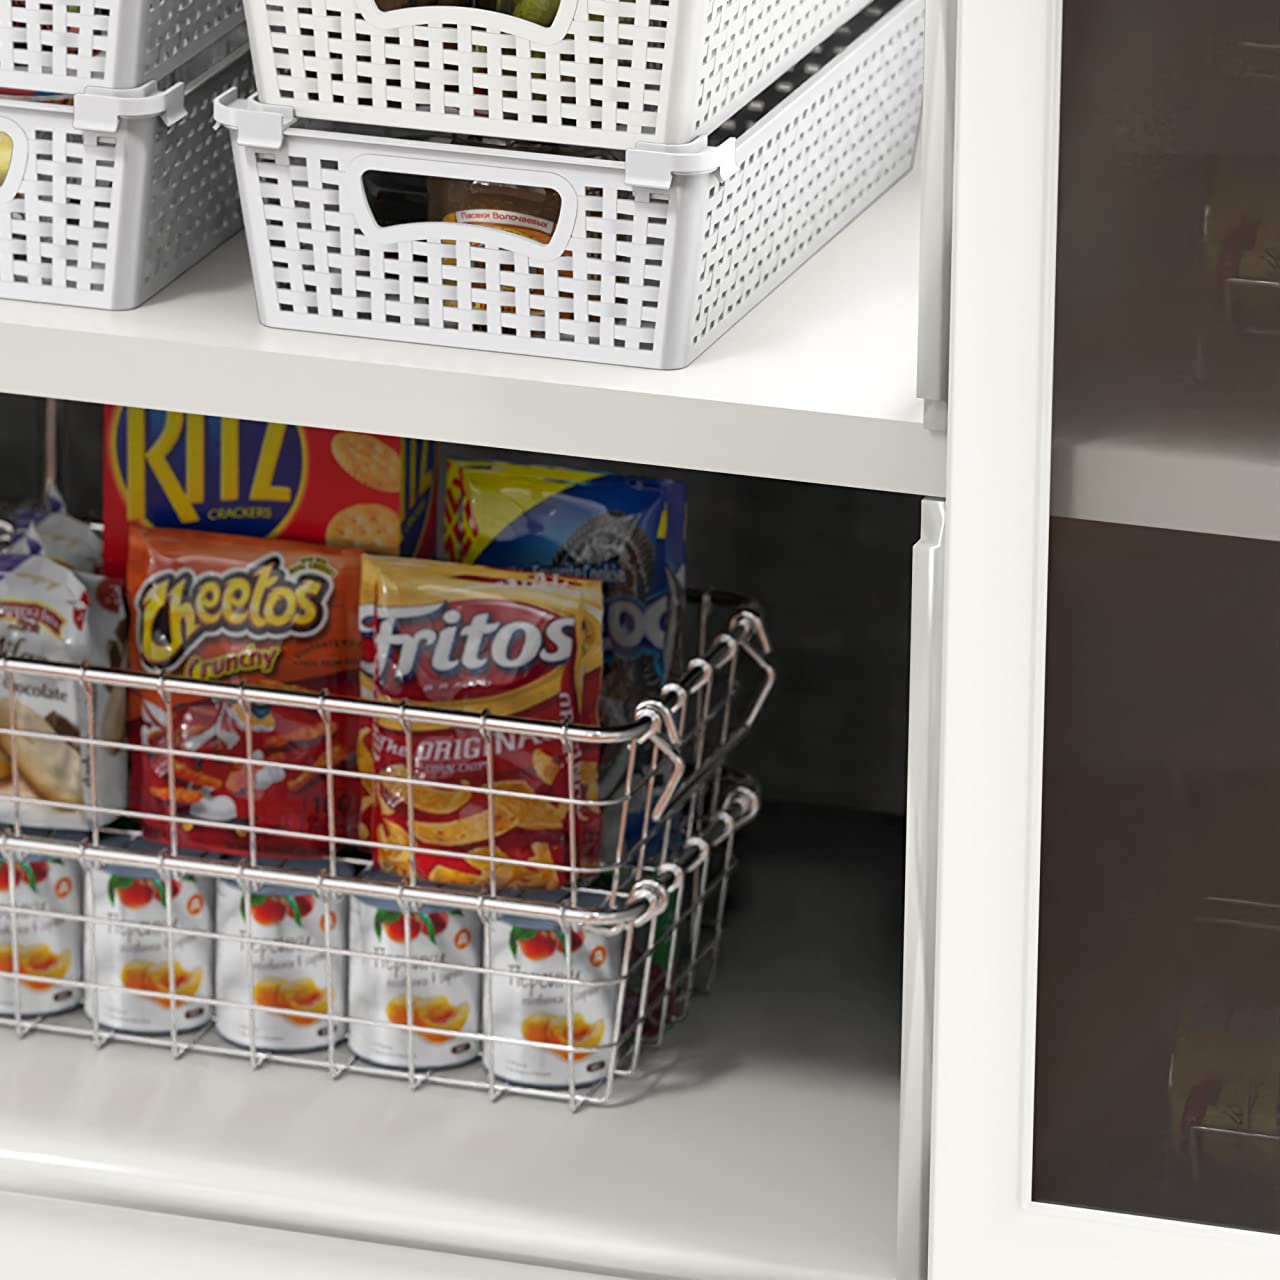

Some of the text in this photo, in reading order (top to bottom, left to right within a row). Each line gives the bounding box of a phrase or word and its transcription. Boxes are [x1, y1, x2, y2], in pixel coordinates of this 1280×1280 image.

[126, 408, 292, 524] RITZ
[208, 506, 273, 521] CRACKERS
[140, 557, 327, 667] Cheetos
[362, 603, 576, 683] Fritos
[186, 645, 282, 678] Crunchy
